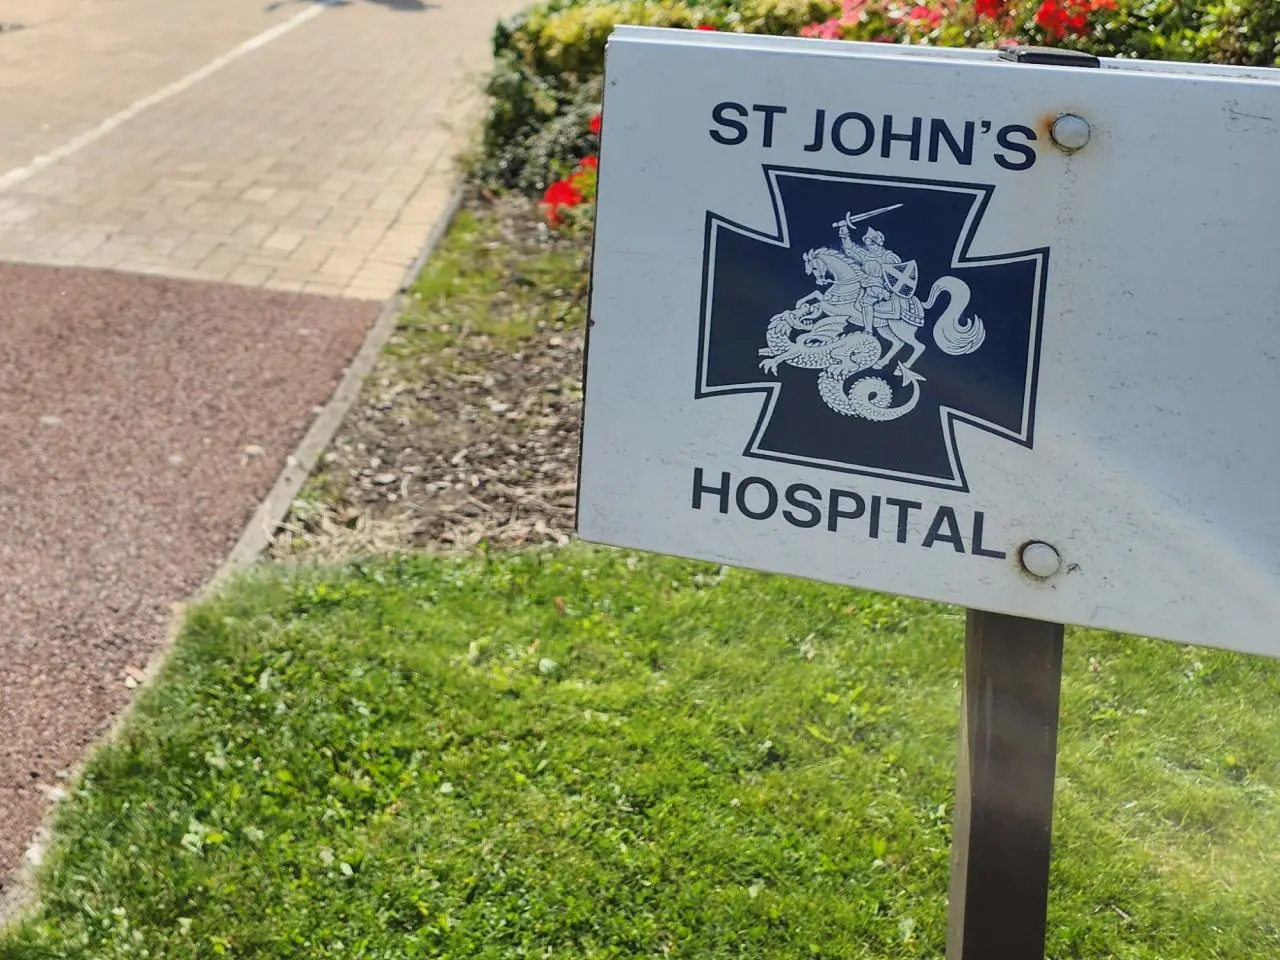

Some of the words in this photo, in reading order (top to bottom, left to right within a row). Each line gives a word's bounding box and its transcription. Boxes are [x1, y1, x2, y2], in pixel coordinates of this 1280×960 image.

[708, 101, 788, 147] ST
[803, 108, 1039, 171] JOHN'S
[690, 467, 1007, 560] HOSPITAL
